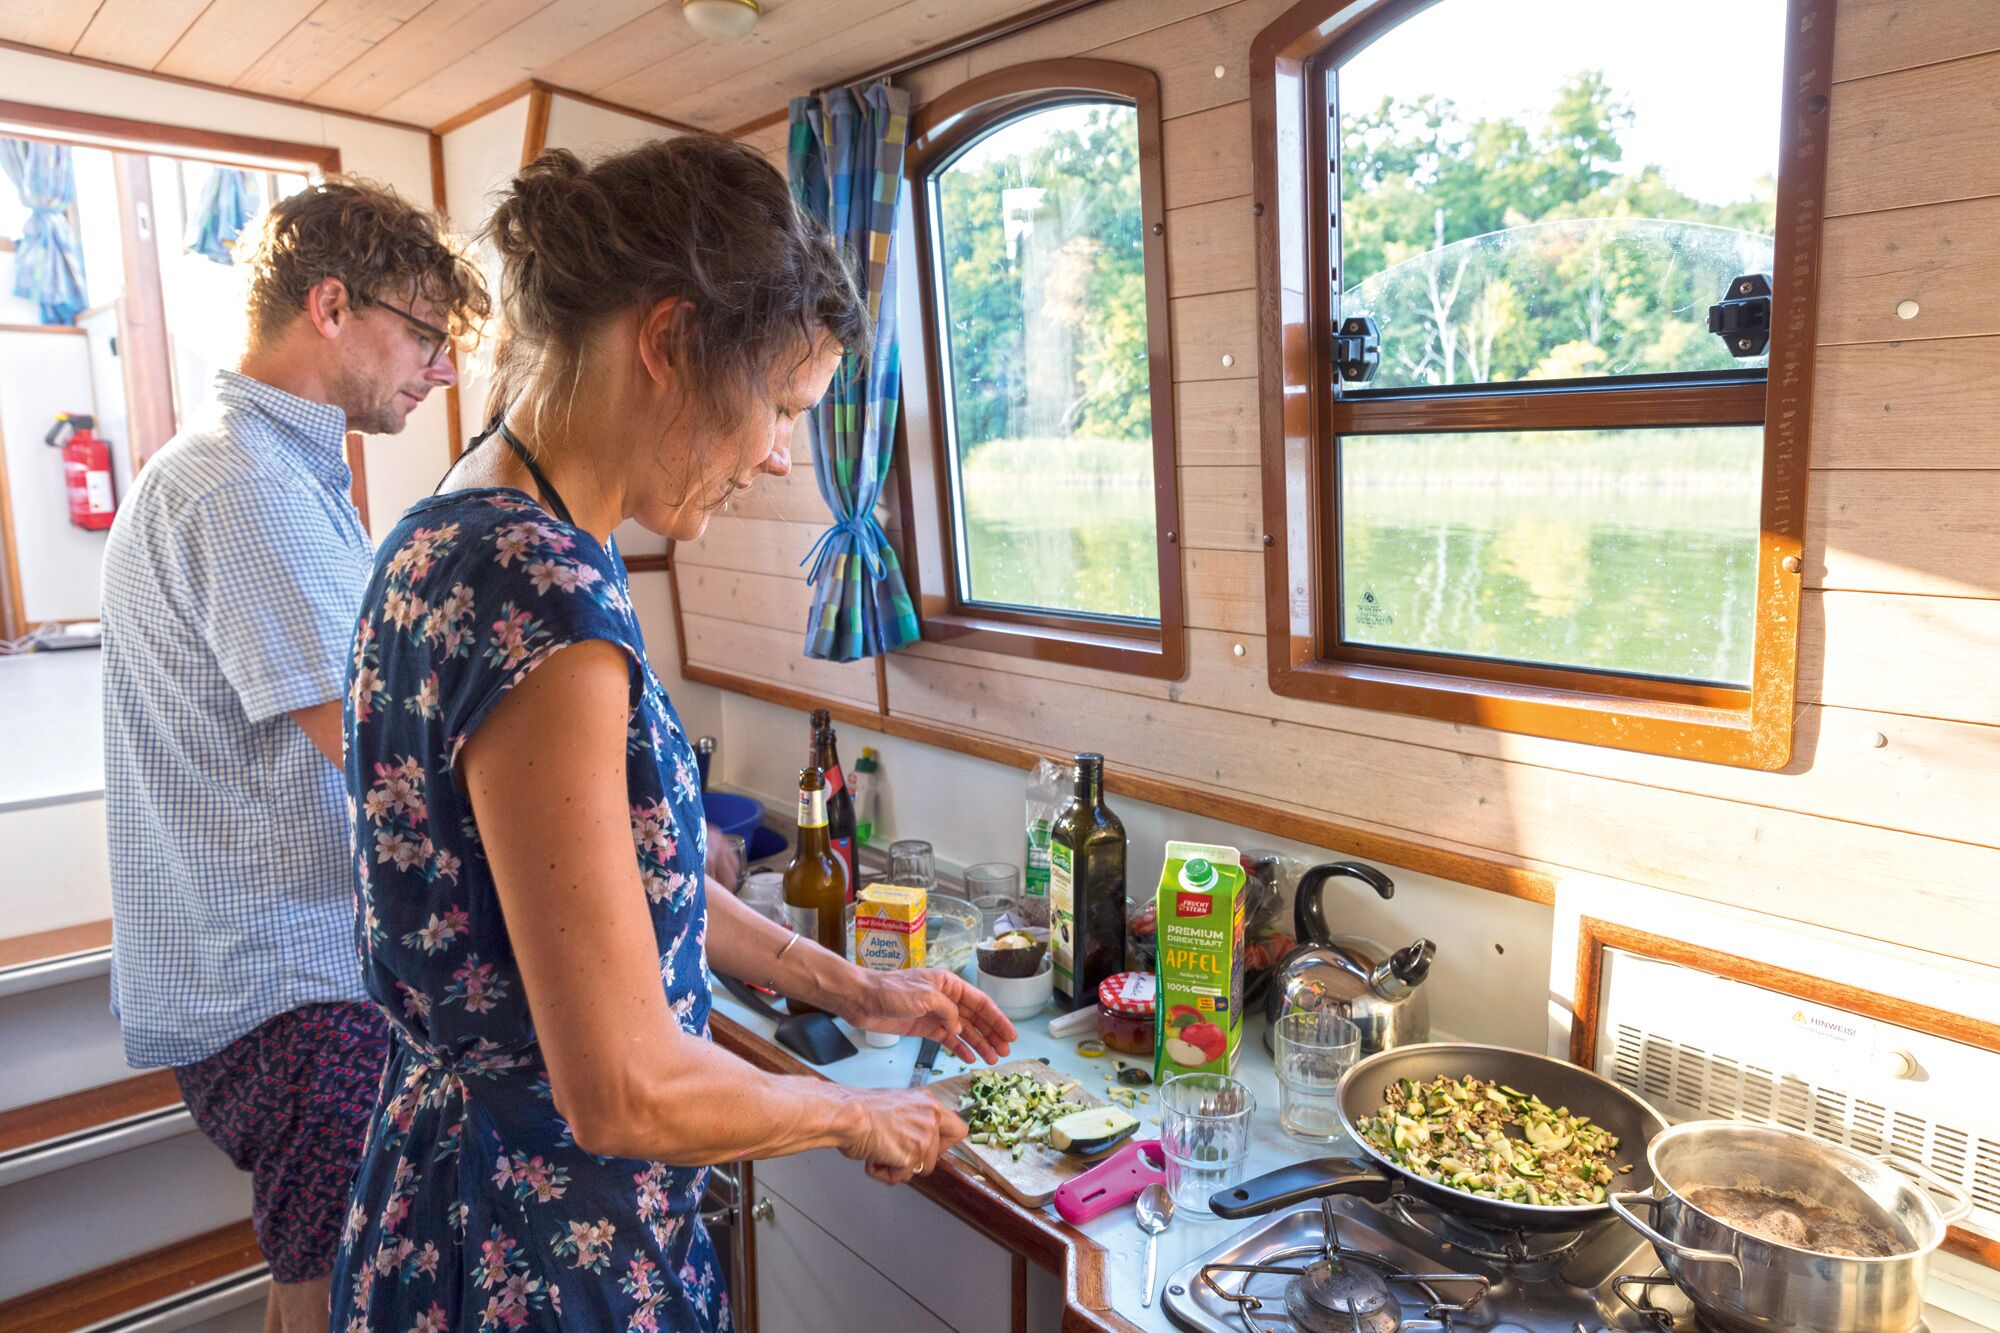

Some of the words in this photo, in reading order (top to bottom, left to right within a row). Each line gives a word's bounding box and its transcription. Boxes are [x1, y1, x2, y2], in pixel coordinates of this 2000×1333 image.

[1183, 900, 1210, 909] FRUCHT
[1186, 906, 1208, 914] STERN
[1167, 924, 1224, 940] PREMIUM
[871, 937, 898, 949] Alpen
[1167, 934, 1223, 948] DIREKTSAFT
[865, 948, 901, 960] JodSalz
[1166, 949, 1223, 974] APFEL
[1167, 982, 1191, 993] 100%
[1810, 1017, 1857, 1037] HINWEIS!
